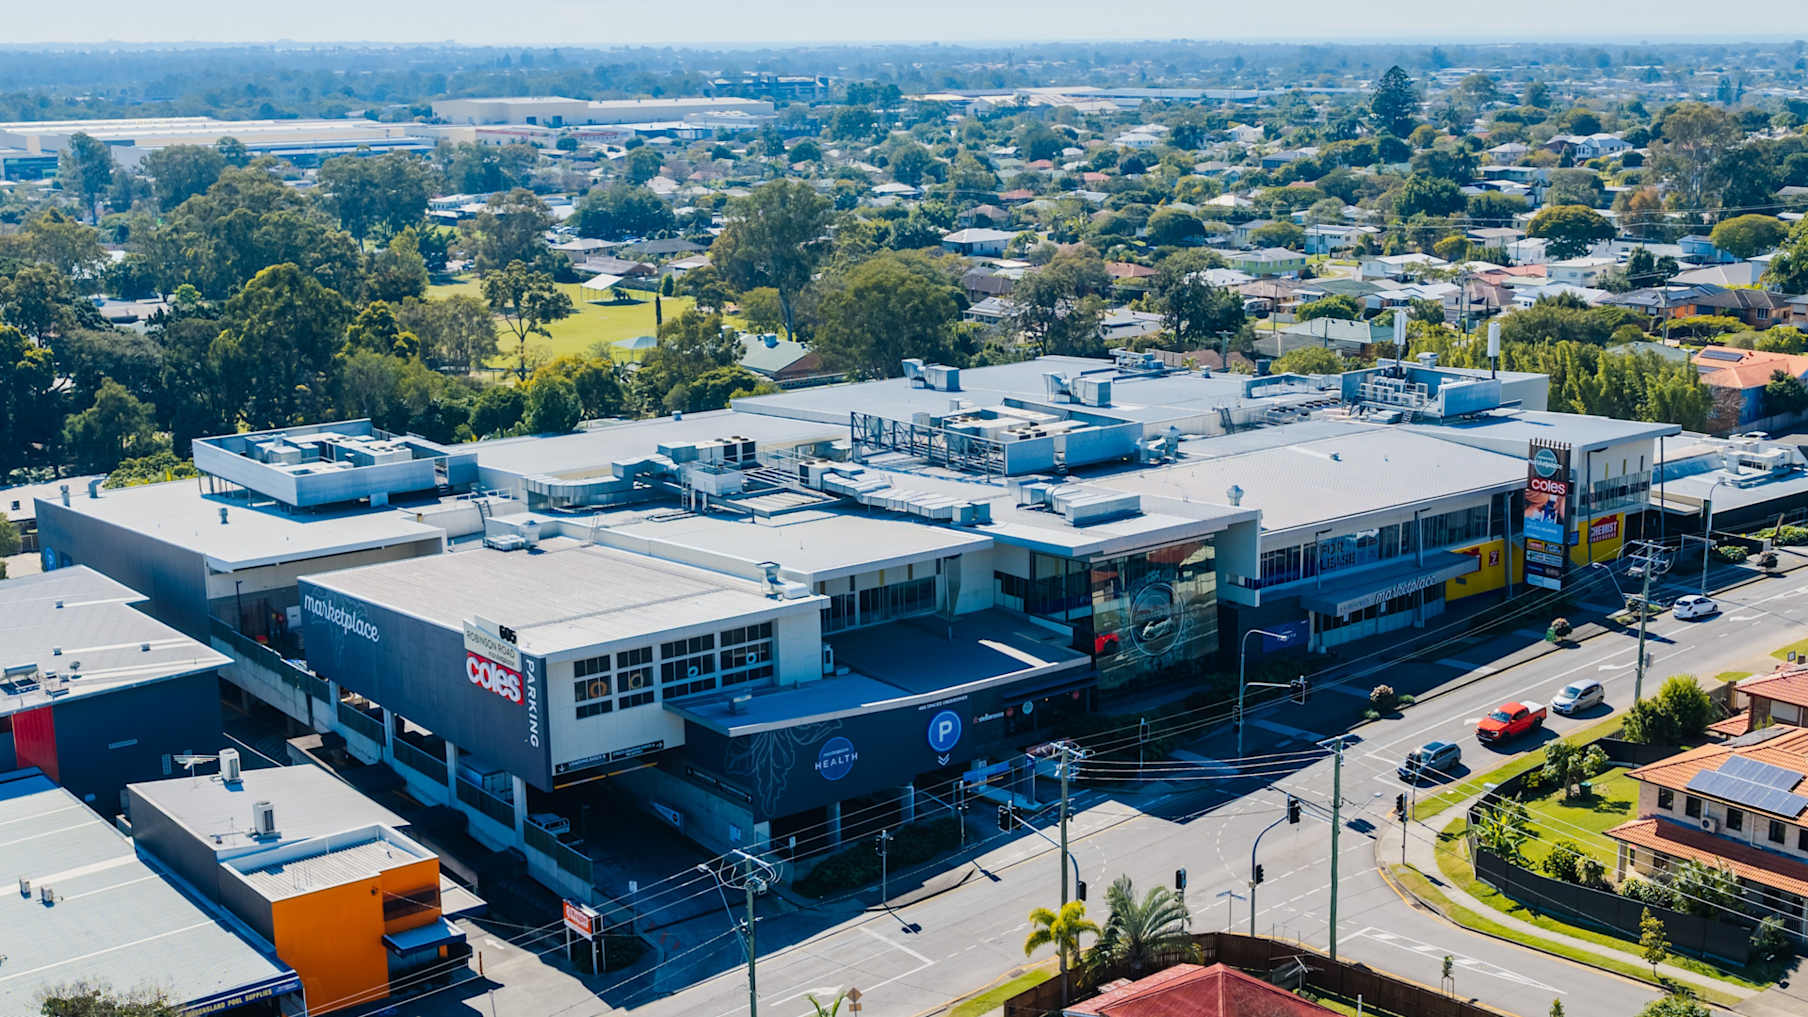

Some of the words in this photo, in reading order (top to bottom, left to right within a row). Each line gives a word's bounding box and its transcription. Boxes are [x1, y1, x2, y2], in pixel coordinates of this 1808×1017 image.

[1531, 479, 1566, 495] coles
[304, 594, 380, 642] marketplace
[466, 656, 521, 702] coles
[525, 659, 540, 748] PARKING
[939, 720, 952, 743] P
[815, 752, 858, 770] HEALTH
[227, 998, 242, 1007] POOL
[245, 989, 272, 1002] SUPPLIES
